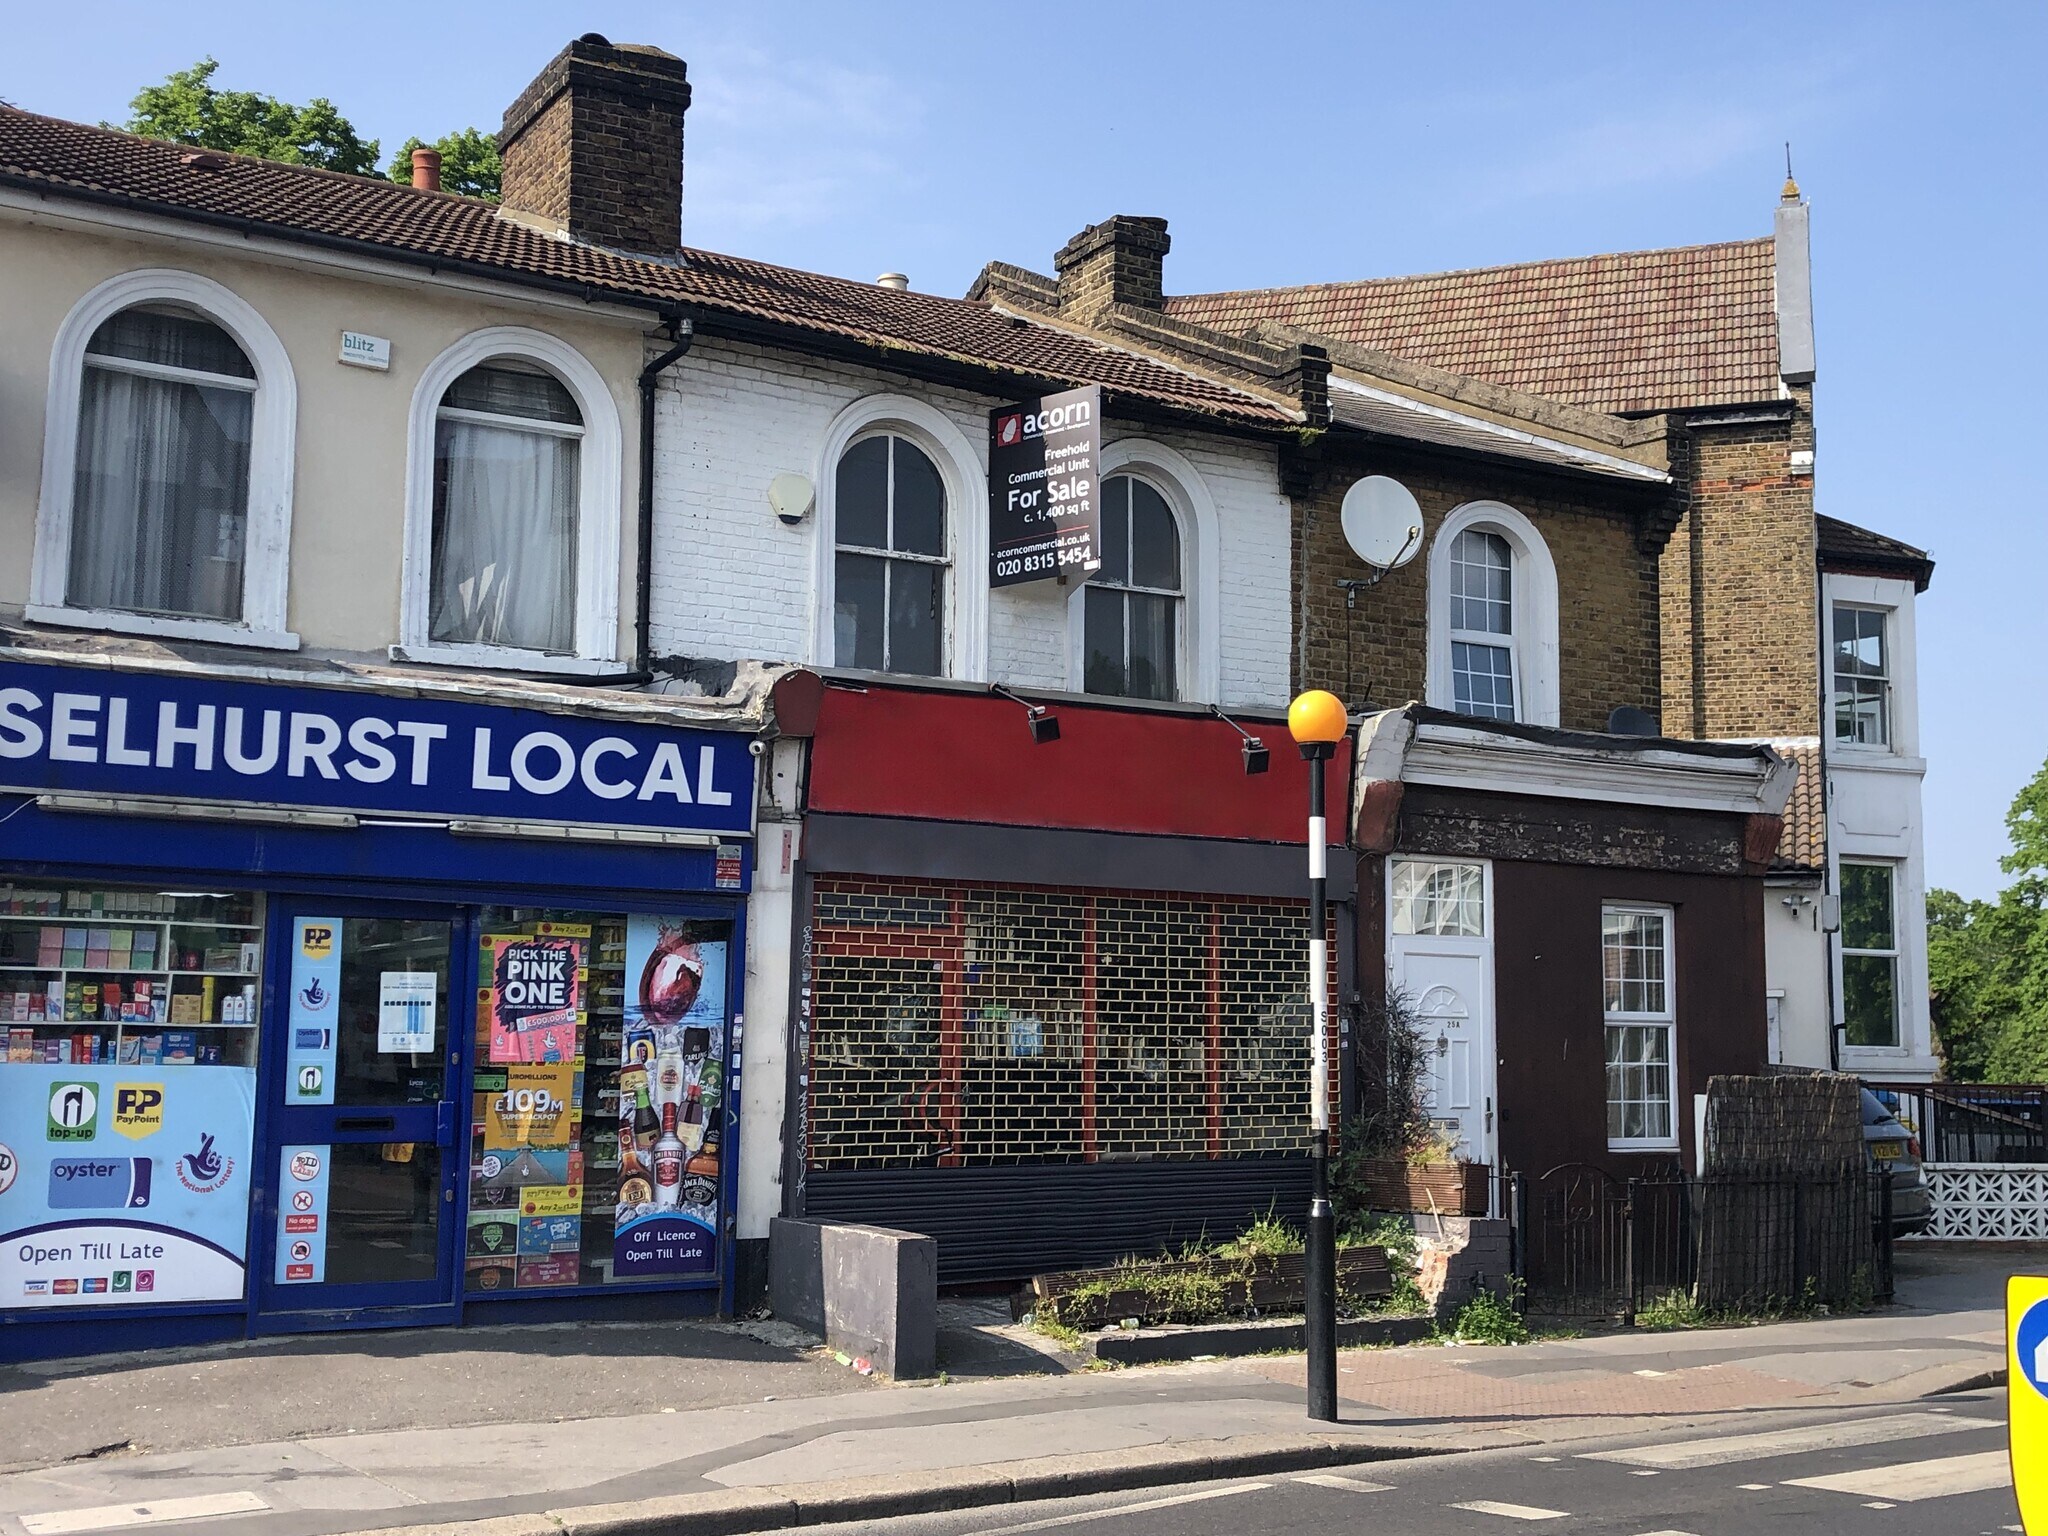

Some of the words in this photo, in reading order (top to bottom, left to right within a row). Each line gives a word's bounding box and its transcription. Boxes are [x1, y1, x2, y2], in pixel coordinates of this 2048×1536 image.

[343, 334, 374, 353] blitz
[1023, 401, 1090, 433] acorn
[1044, 441, 1089, 461] Freehold
[1008, 462, 1065, 484] Commercial
[1068, 458, 1089, 472] Unit
[1007, 489, 1042, 511] For
[1047, 478, 1089, 503] Sale
[1024, 513, 1033, 522] c.
[1036, 505, 1065, 522] 1,400
[1066, 503, 1079, 515] sq
[1081, 500, 1089, 511] ft
[997, 532, 1090, 558] acorncommercial.co.uk
[997, 561, 1021, 577] 020
[1024, 553, 1054, 571] 8315
[1057, 545, 1091, 566] 5454
[0, 688, 447, 786] SELHURST
[473, 727, 732, 806] LOCAL
[508, 949, 538, 960] PICK
[541, 950, 567, 960] THE
[507, 960, 565, 980] PINK
[505, 981, 565, 1004] ONE
[1447, 1021, 1460, 1029] 25A
[116, 1090, 161, 1114] PP
[495, 1089, 564, 1112] £109M
[116, 1115, 160, 1124] PayPoint
[49, 1127, 93, 1140] top-up
[654, 1150, 682, 1159] SMIRNOFF
[54, 1162, 116, 1181] oyster
[175, 1160, 184, 1176] The
[180, 1176, 214, 1193] National
[215, 1160, 235, 1188] Lottery
[683, 1178, 698, 1189] JACK
[298, 1217, 315, 1225] dogs
[634, 1232, 650, 1242] Off
[657, 1231, 696, 1241] Licence
[20, 1245, 72, 1265] Open
[80, 1243, 111, 1260] Till
[120, 1243, 163, 1259] Late
[626, 1251, 652, 1262] Open
[656, 1249, 673, 1259] Till
[680, 1248, 702, 1258] Late
